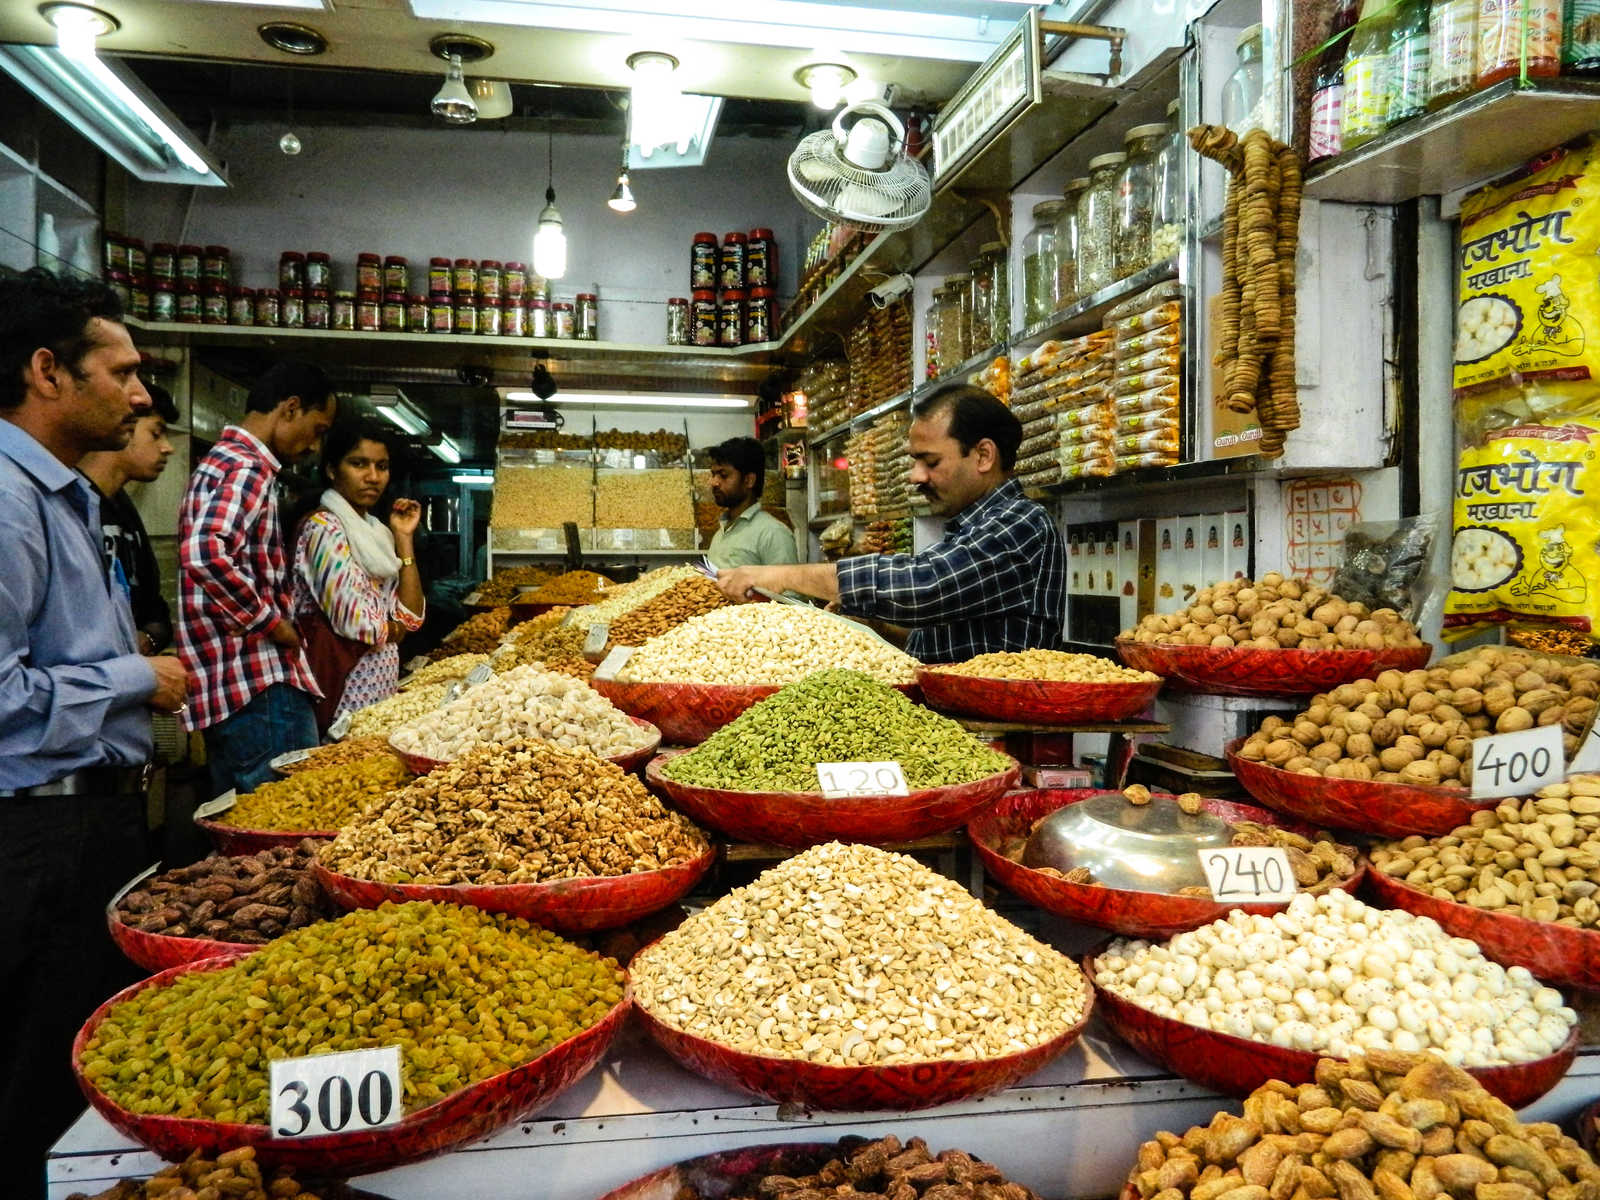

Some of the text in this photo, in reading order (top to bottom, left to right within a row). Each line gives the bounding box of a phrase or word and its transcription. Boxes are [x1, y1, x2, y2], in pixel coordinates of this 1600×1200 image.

[1467, 259, 1533, 290] मखाना
[1467, 502, 1538, 520] मखाना
[823, 767, 899, 792] 120
[1477, 743, 1551, 786] 400
[1209, 852, 1284, 897] 240
[278, 1069, 393, 1137] 300
